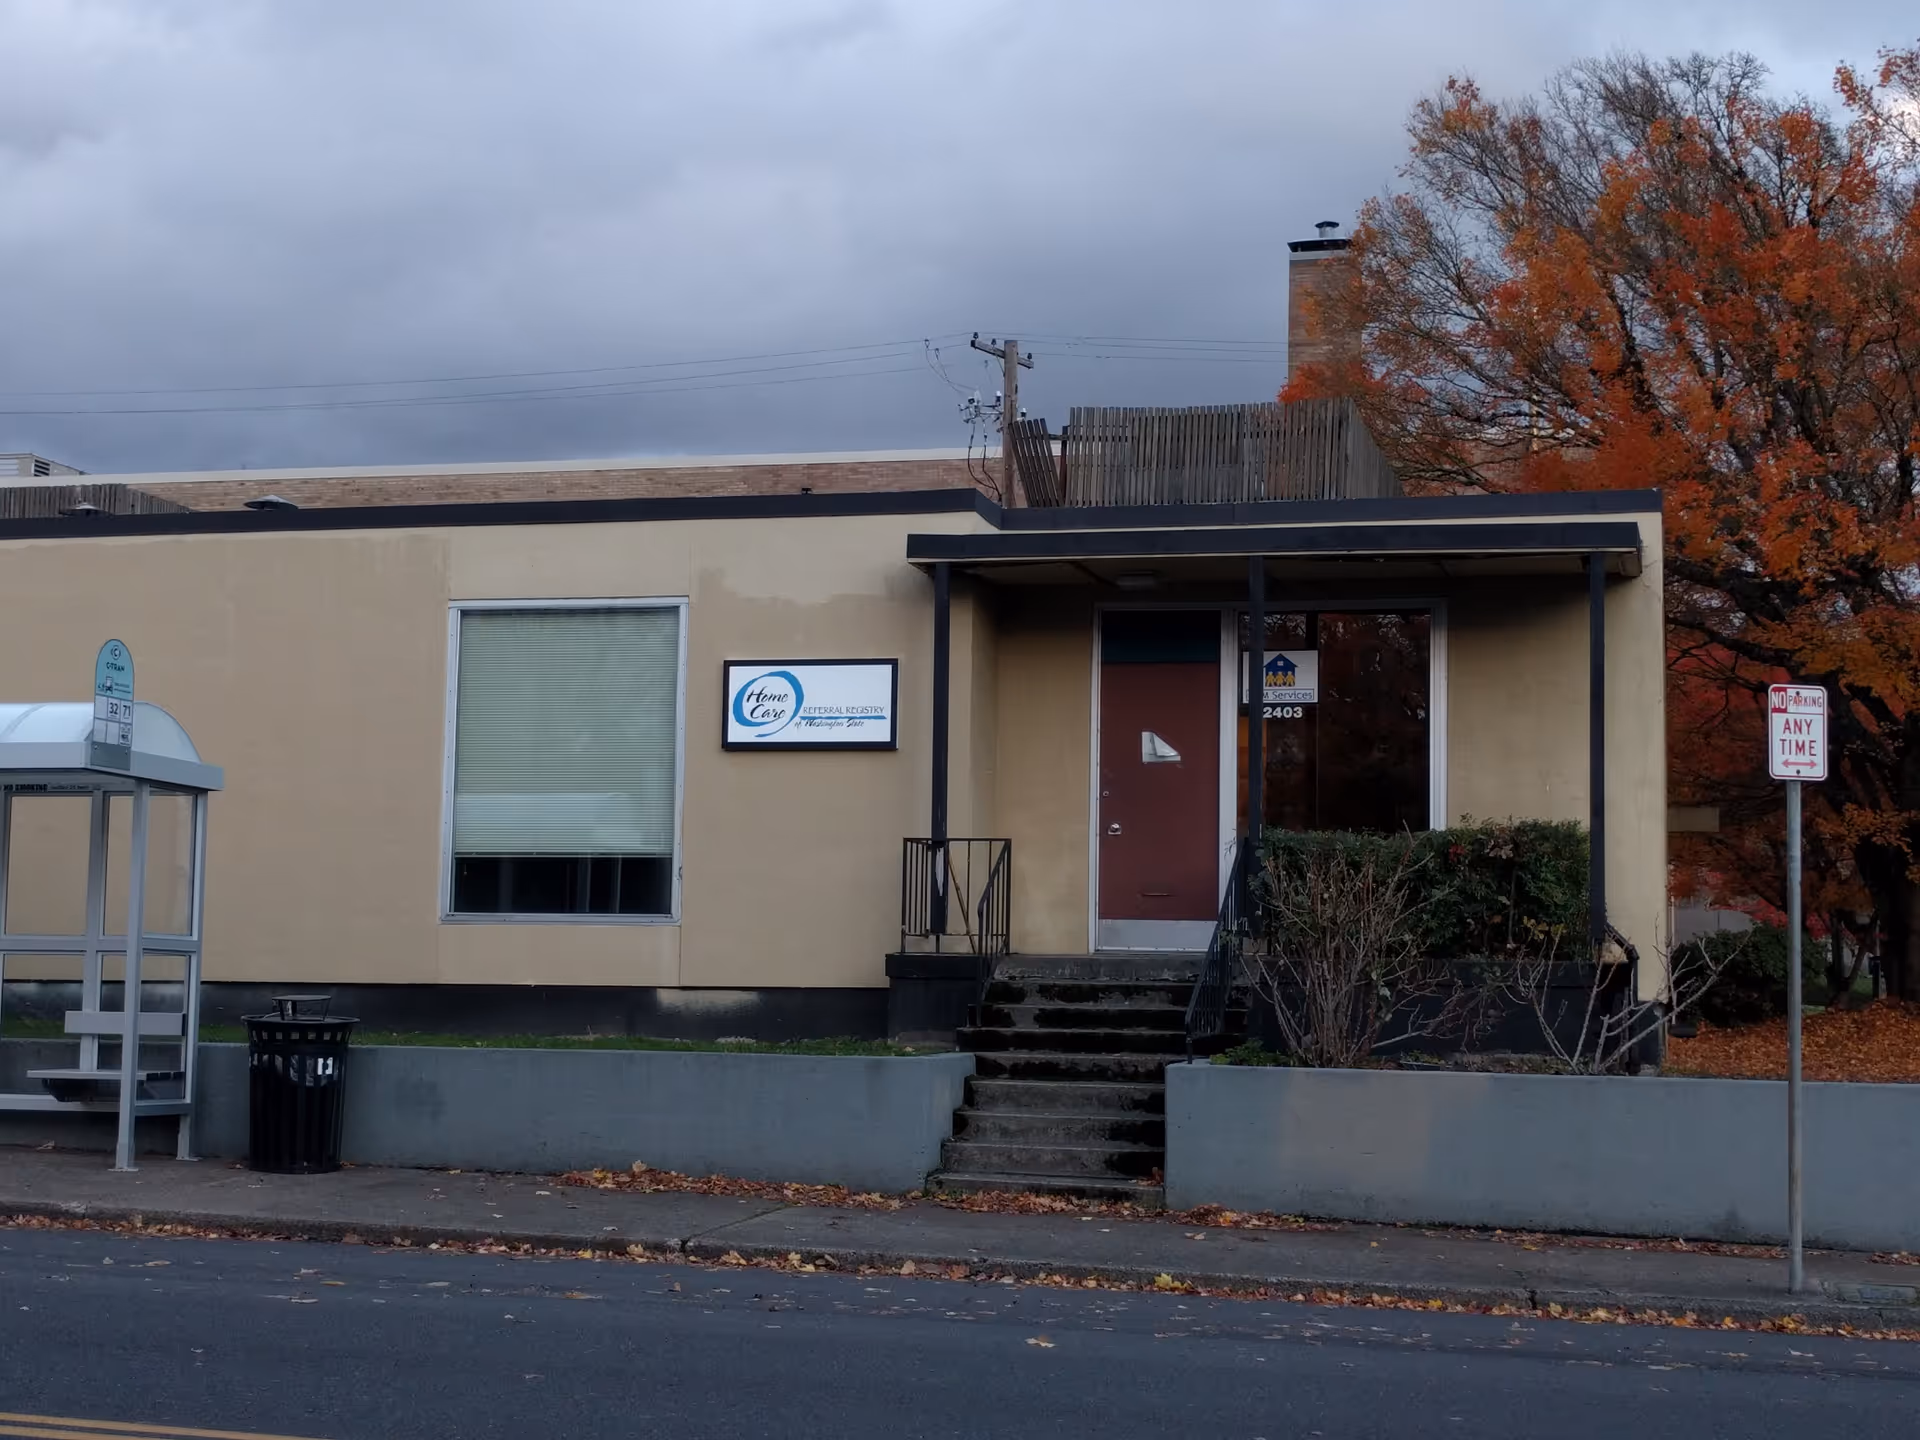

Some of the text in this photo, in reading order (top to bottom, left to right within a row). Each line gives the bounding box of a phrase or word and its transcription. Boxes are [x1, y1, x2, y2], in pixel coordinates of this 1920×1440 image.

[746, 686, 789, 704] Home
[1272, 690, 1313, 700] Services
[1771, 691, 1823, 709] NO PARKING
[109, 702, 131, 717] 32 71
[749, 703, 786, 720] Care
[803, 705, 885, 715] REFERRAL REGISTRY
[1262, 706, 1303, 718] 2403
[795, 718, 865, 731] of Washington State
[1783, 717, 1813, 736] ANY
[1779, 738, 1817, 757] TIME
